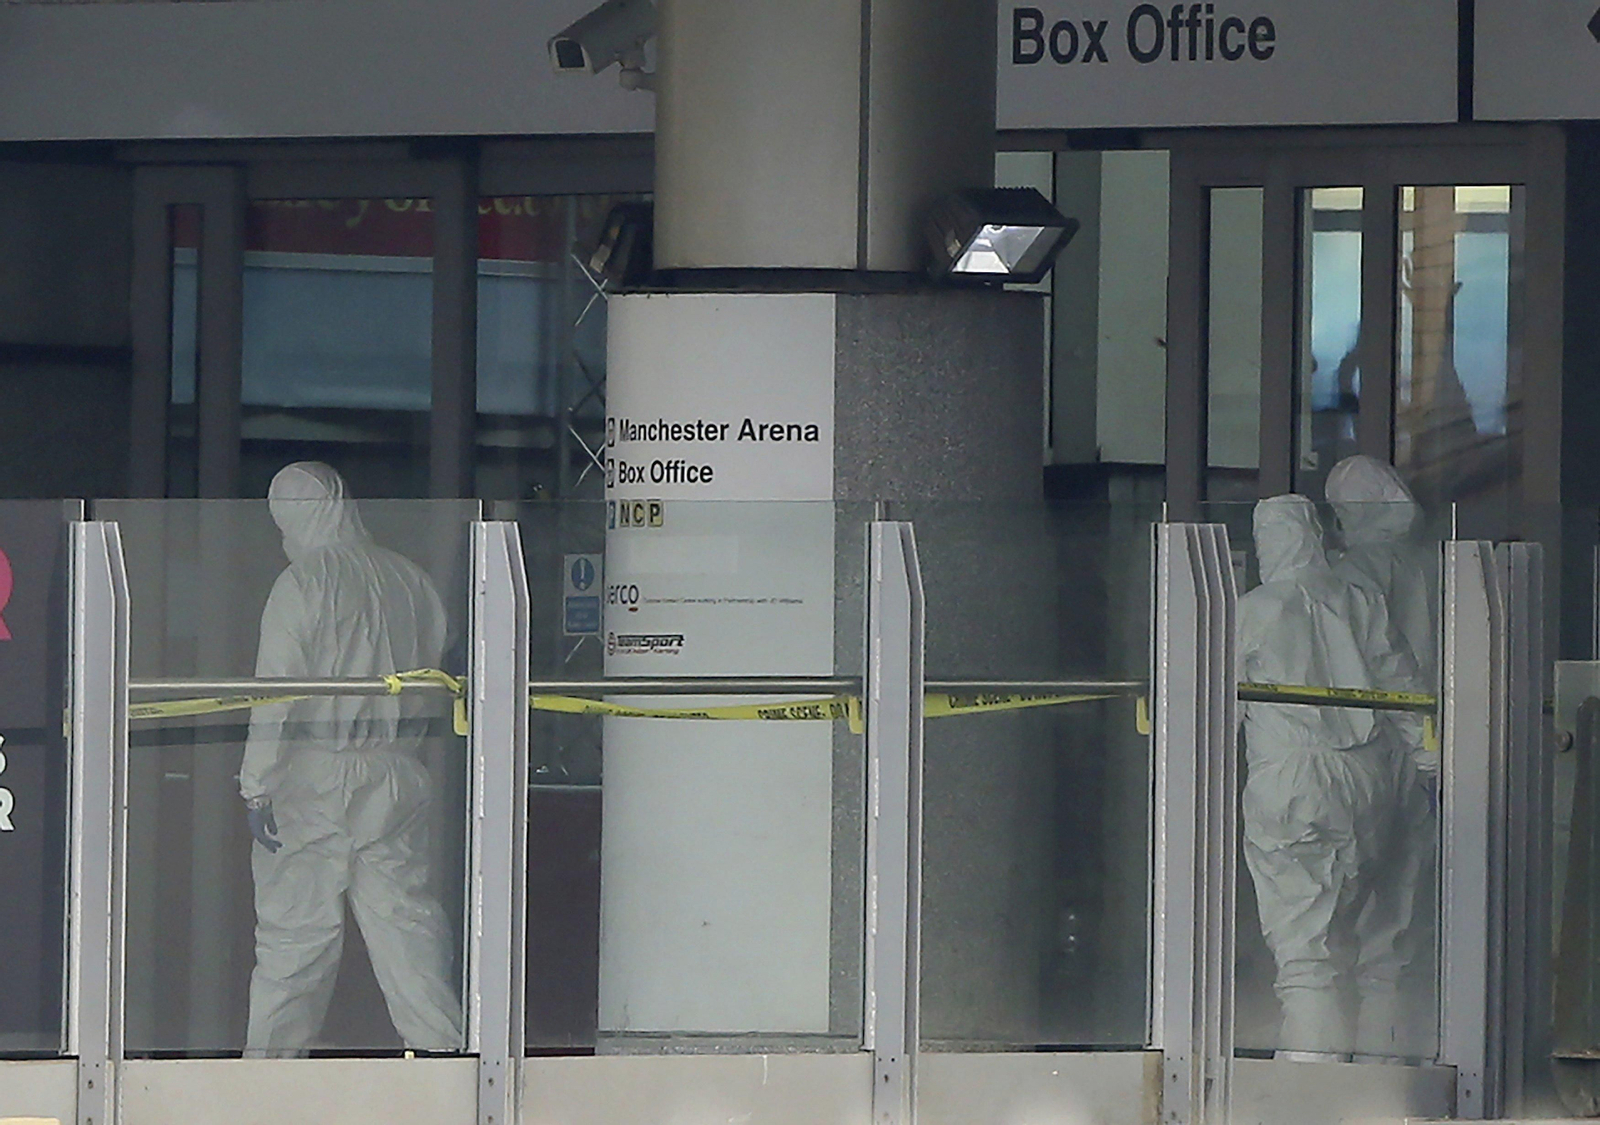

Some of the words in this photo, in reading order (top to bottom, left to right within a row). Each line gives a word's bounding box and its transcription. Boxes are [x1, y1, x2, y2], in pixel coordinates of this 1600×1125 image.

[1012, 7, 1109, 64] Box
[1126, 3, 1276, 63] Office
[619, 418, 729, 442] Manchester
[737, 417, 819, 442] Arena
[618, 460, 645, 484] Box
[650, 460, 714, 484] Office
[620, 503, 662, 524] NCP
